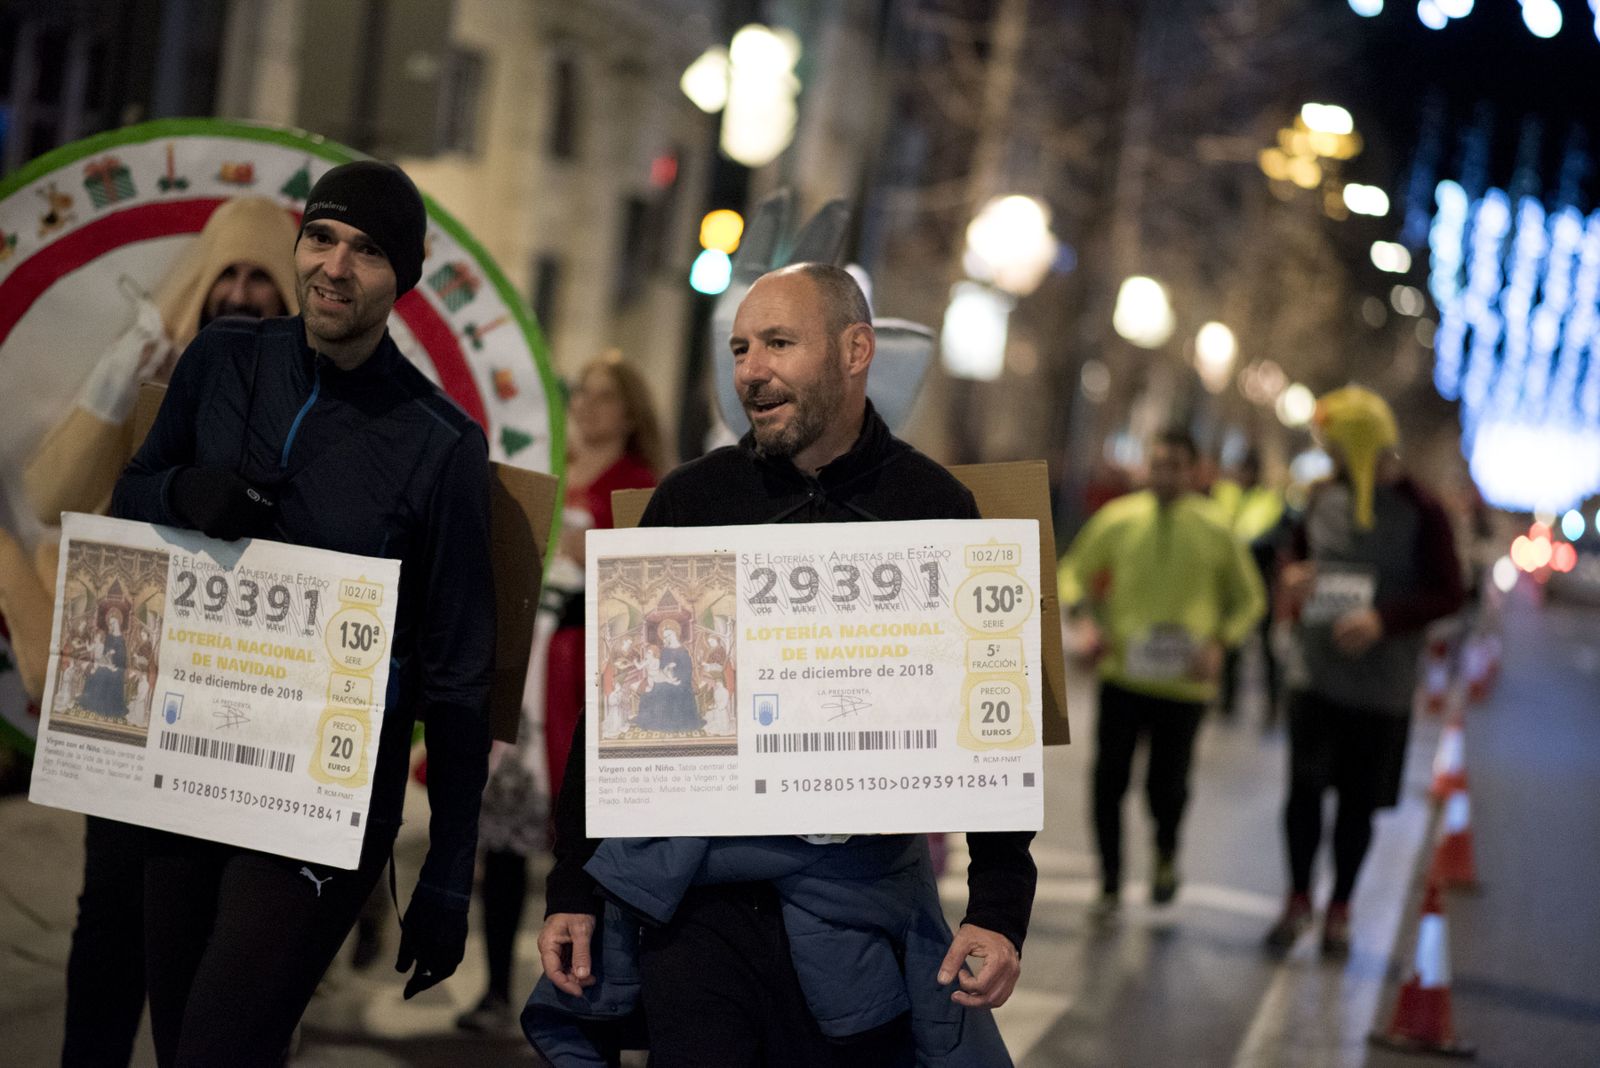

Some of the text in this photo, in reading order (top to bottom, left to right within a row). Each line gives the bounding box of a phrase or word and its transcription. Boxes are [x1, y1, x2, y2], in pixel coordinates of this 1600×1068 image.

[972, 549, 1014, 562] 102/18
[749, 561, 939, 604] 29391
[174, 571, 319, 626] 29391
[345, 585, 377, 600] 102/18
[745, 622, 944, 641] LOTERÍA NACIONAL
[983, 619, 1005, 628] SERIE
[168, 628, 316, 663] LOTERÍA NACIONAL
[782, 644, 910, 661] DE NAVIDAD
[192, 652, 287, 679] DE NAVIDAD
[345, 655, 362, 665] SERIE
[972, 659, 1017, 669] FRACCIÓN
[758, 664, 934, 680] 22 de diciembre de 2018
[173, 668, 303, 701] 22 de diciembre de 2018
[980, 686, 1010, 695] PRECIO
[981, 701, 1010, 723] 20
[332, 721, 357, 732] PRECIO
[330, 735, 353, 760] 20
[327, 762, 351, 773] EUROS
[598, 765, 624, 774] Virgen
[645, 764, 652, 772] el
[699, 762, 725, 770] central
[727, 762, 739, 770] del
[631, 775, 640, 783] de
[652, 775, 668, 783] Vida
[671, 774, 681, 782] de
[693, 774, 718, 784] Virgen
[781, 774, 1009, 792] 5102805130>0293912841
[598, 786, 613, 794] San
[659, 785, 686, 793] Museo
[690, 785, 723, 793] Nacional
[726, 783, 739, 791] del
[172, 778, 342, 822] 5102805130>0293912841
